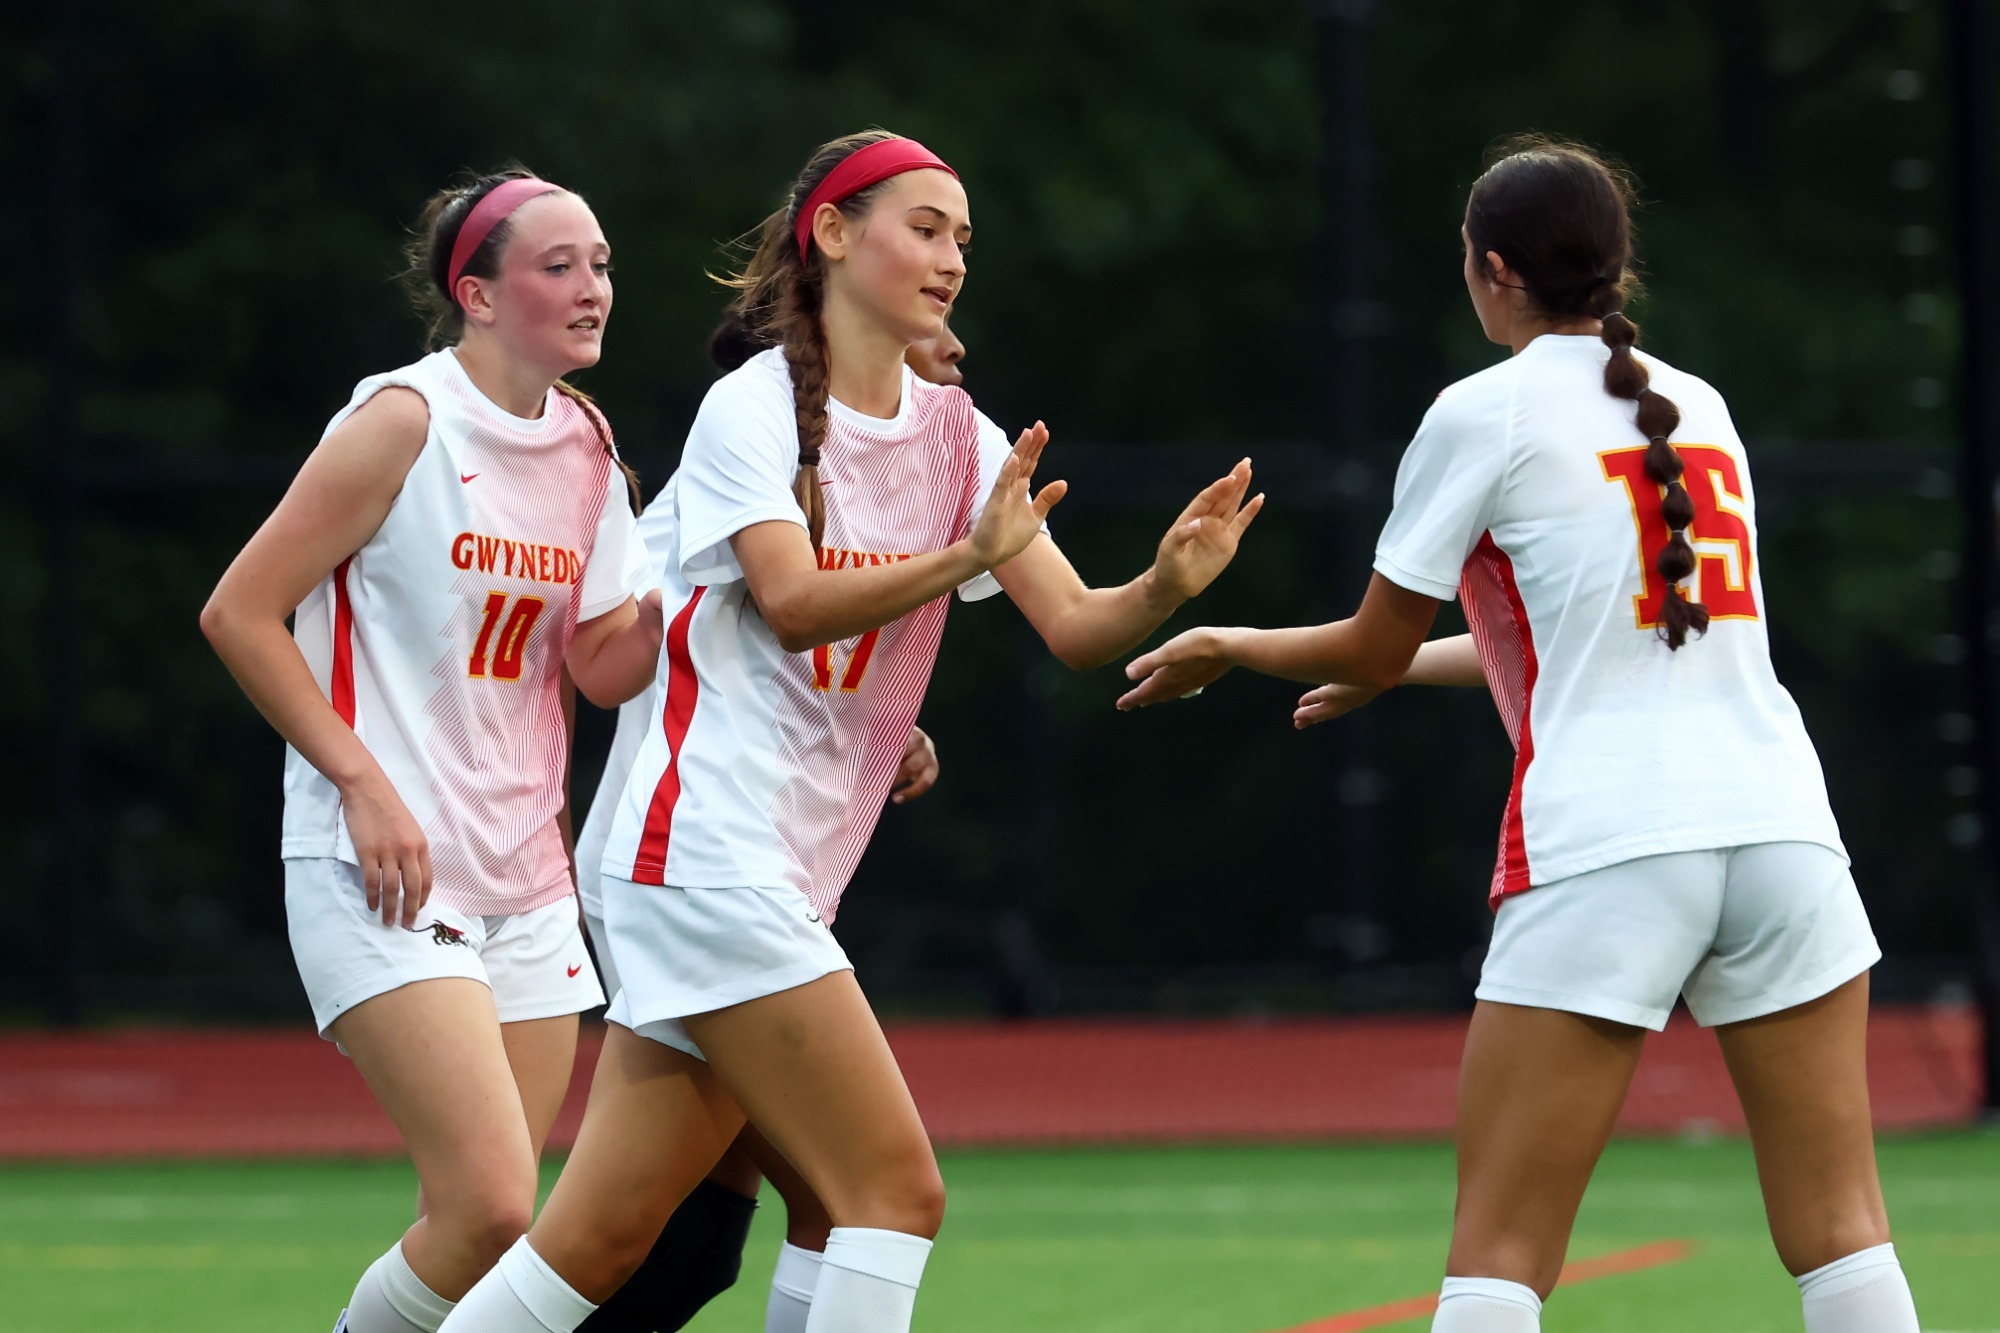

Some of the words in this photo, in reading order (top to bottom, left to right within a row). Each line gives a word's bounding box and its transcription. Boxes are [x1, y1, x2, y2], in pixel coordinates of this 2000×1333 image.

[451, 531, 582, 586] GWYNEDD
[1596, 443, 1760, 630] 15
[468, 590, 546, 682] 10
